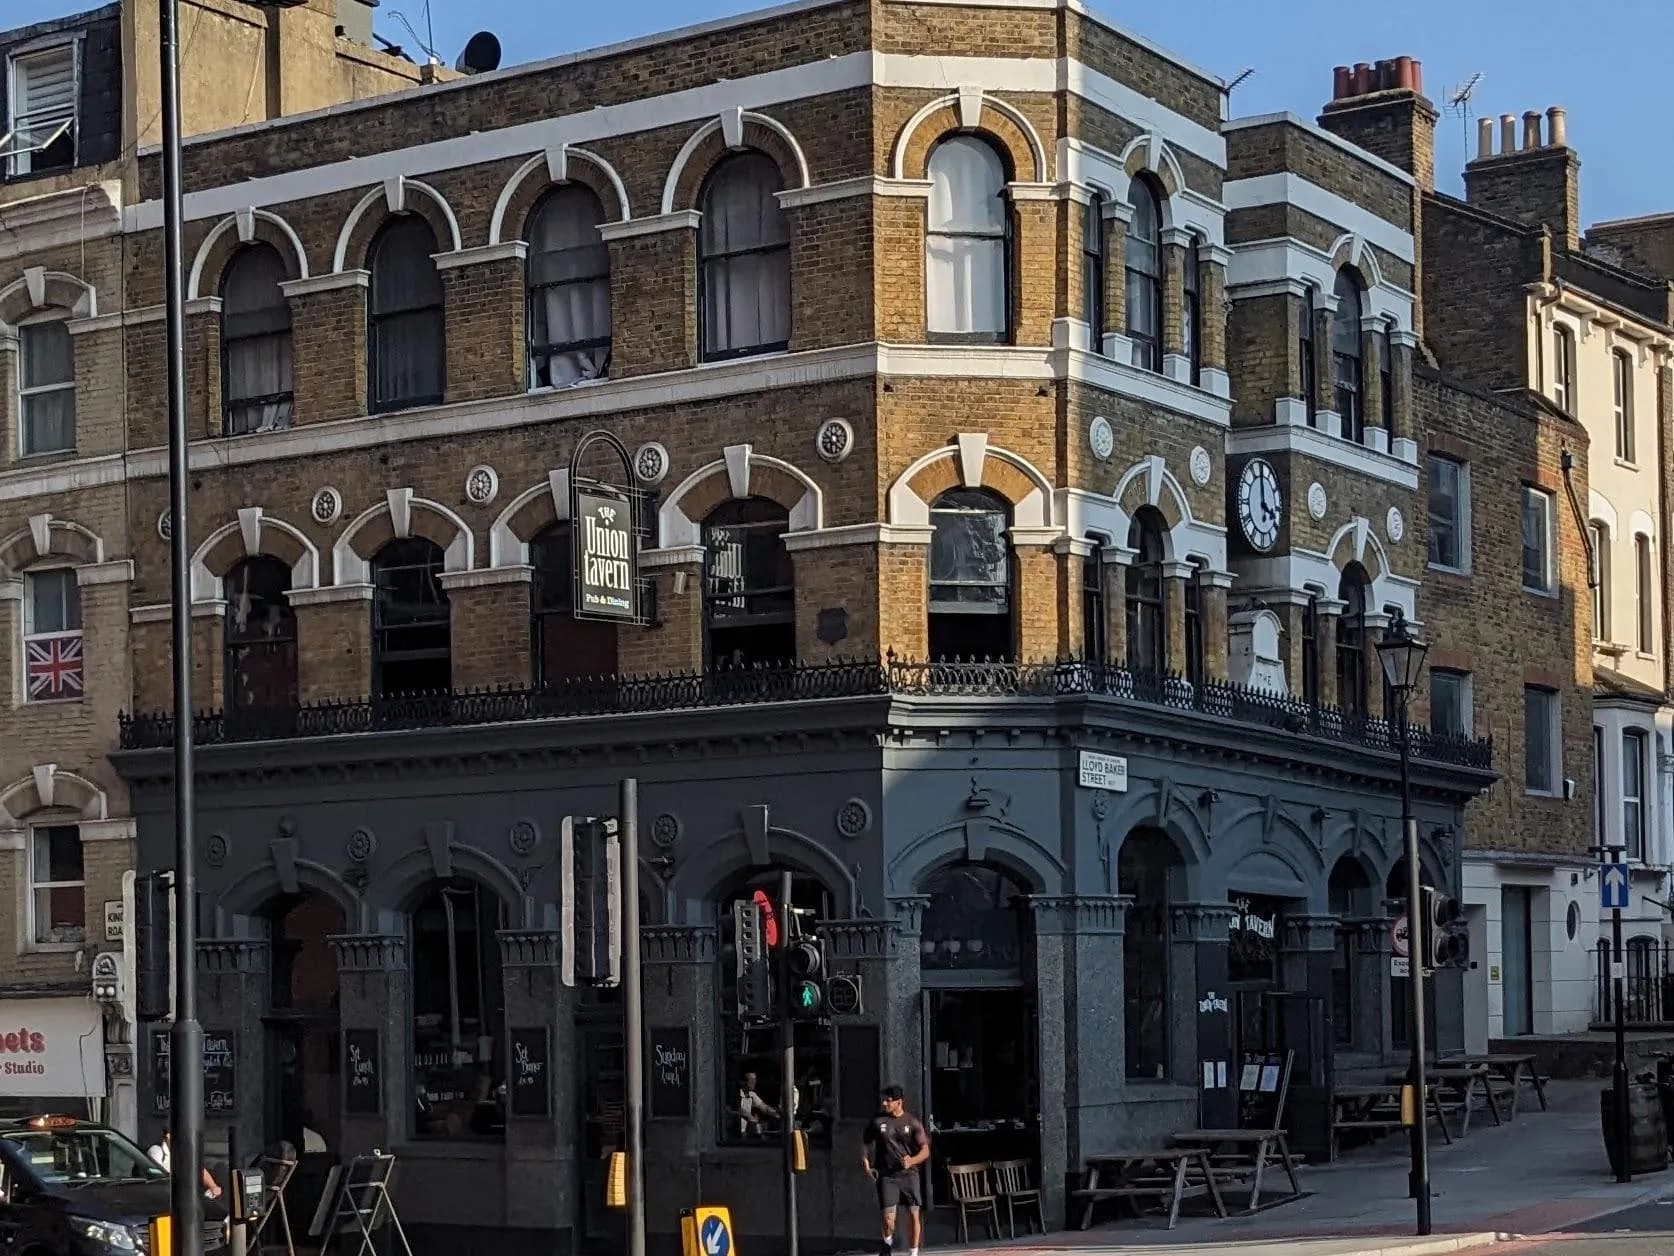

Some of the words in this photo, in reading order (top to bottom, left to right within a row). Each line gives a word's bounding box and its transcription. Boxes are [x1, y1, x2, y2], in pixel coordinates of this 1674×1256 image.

[597, 506, 617, 523] THE
[585, 516, 630, 560] Union
[583, 549, 631, 591] tavern
[586, 593, 600, 605] Pub
[600, 595, 607, 605] &
[606, 596, 630, 610] Dining
[1082, 758, 1104, 773] LLOYD
[1104, 761, 1125, 776] BAKER
[1081, 770, 1107, 785] STREET
[107, 925, 124, 937] ROA
[4, 1060, 45, 1075] Studio
